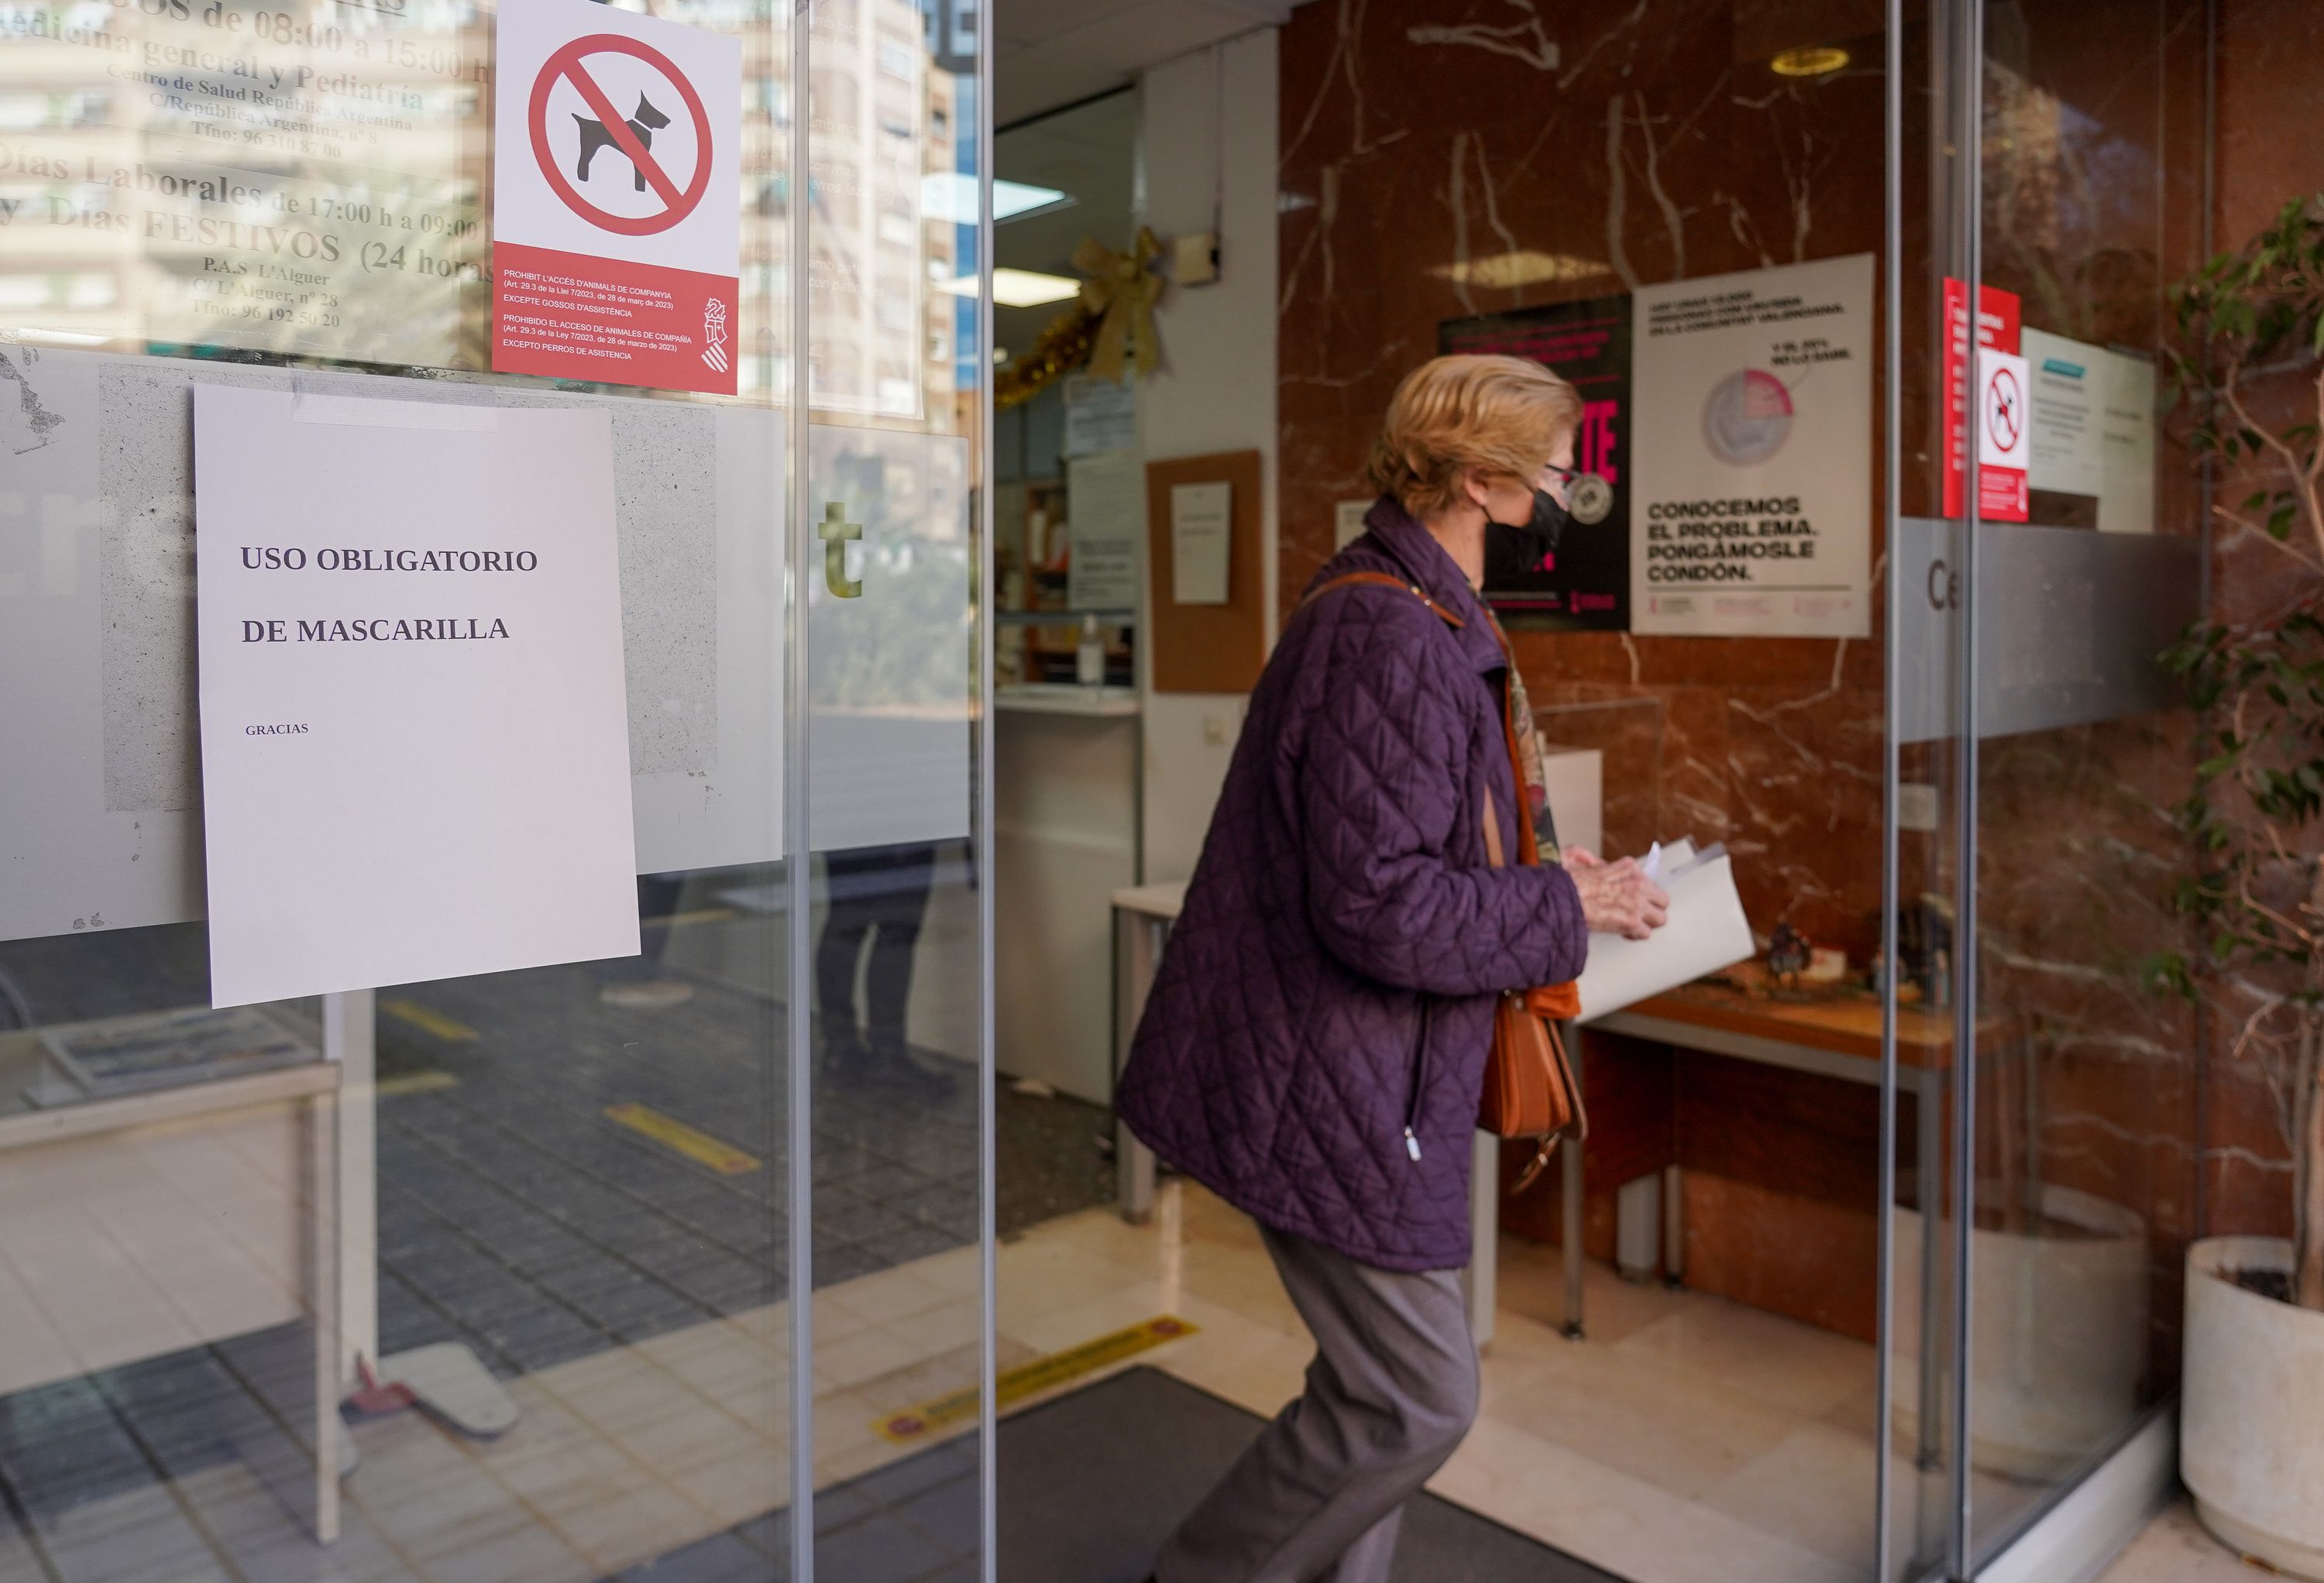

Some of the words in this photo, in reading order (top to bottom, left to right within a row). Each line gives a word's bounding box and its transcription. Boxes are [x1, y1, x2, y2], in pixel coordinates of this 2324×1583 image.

[203, 2, 242, 32] de
[254, 11, 342, 53] 08:00
[354, 39, 370, 59] a
[383, 38, 462, 78] 15:00
[0, 9, 130, 55] edicina
[143, 40, 259, 81] general
[269, 65, 285, 90] y
[295, 65, 423, 111] Pediatría
[107, 64, 167, 88] Centro
[173, 77, 194, 91] de
[198, 80, 246, 101] Salud
[253, 90, 329, 117] República
[336, 107, 412, 132] Argentina
[150, 92, 255, 125] C/República
[260, 114, 342, 139] Argentina,
[191, 120, 237, 141] Tfno:
[243, 130, 262, 146] 96
[267, 134, 296, 151] 310
[324, 144, 341, 159] 00
[81, 155, 262, 208] Laborales
[271, 192, 300, 213] de
[308, 197, 371, 224] 17:00
[378, 207, 392, 228] h
[401, 215, 413, 230] a
[420, 213, 478, 240] 09:00
[46, 196, 130, 234] Días
[143, 209, 340, 262] FESTIVOS
[360, 241, 407, 273] (24
[203, 257, 248, 275] P.A.S
[260, 264, 330, 286] L'Alguer
[504, 269, 541, 281] PROHIBIT
[543, 275, 575, 286] L'ACCÉS
[576, 280, 616, 292] D'ANIMALS
[629, 287, 672, 300] COMPANYIA
[194, 277, 214, 292] C/
[321, 293, 339, 307] 28
[504, 280, 518, 288] (Art.
[521, 282, 536, 290] 29.3
[571, 289, 596, 299] 7/2023,
[597, 292, 606, 300] de
[607, 294, 616, 302] 28
[617, 295, 626, 304] de
[627, 297, 644, 307] març
[655, 300, 673, 310] 2023)
[504, 294, 540, 306] EXCEPTE
[542, 299, 575, 310] GOSSOS
[191, 299, 235, 317] Tfno:
[242, 304, 261, 319] 96
[267, 307, 294, 324] 192
[300, 311, 318, 327] 50
[322, 314, 339, 328] 20
[504, 314, 547, 326] PROHIBIDO
[549, 319, 559, 328] EL
[559, 321, 591, 331] ACCESO
[605, 327, 642, 338] ANIMALES
[644, 331, 654, 339] DE
[503, 339, 541, 350] EXCEPTO
[542, 343, 574, 354] PERROS
[588, 349, 632, 360] ASISTENCIA
[504, 324, 518, 333] (Art.
[521, 326, 536, 335] 29.3
[556, 331, 569, 339] Ley
[571, 333, 595, 342] 7/2023,
[658, 344, 677, 352] 2023)
[1648, 496, 1800, 520] CONOCEMOS
[1648, 524, 1673, 541] EL
[1678, 519, 1818, 539] PROBLEMA.
[240, 547, 307, 570] USO
[317, 548, 538, 572] OBLIGATORIO
[1648, 538, 1814, 561] PONGÁMOSLE
[1648, 561, 1754, 582] CONDÓN.
[242, 620, 287, 643] DE
[297, 618, 511, 642] MASCARILLA
[246, 723, 309, 737] GRACIAS
